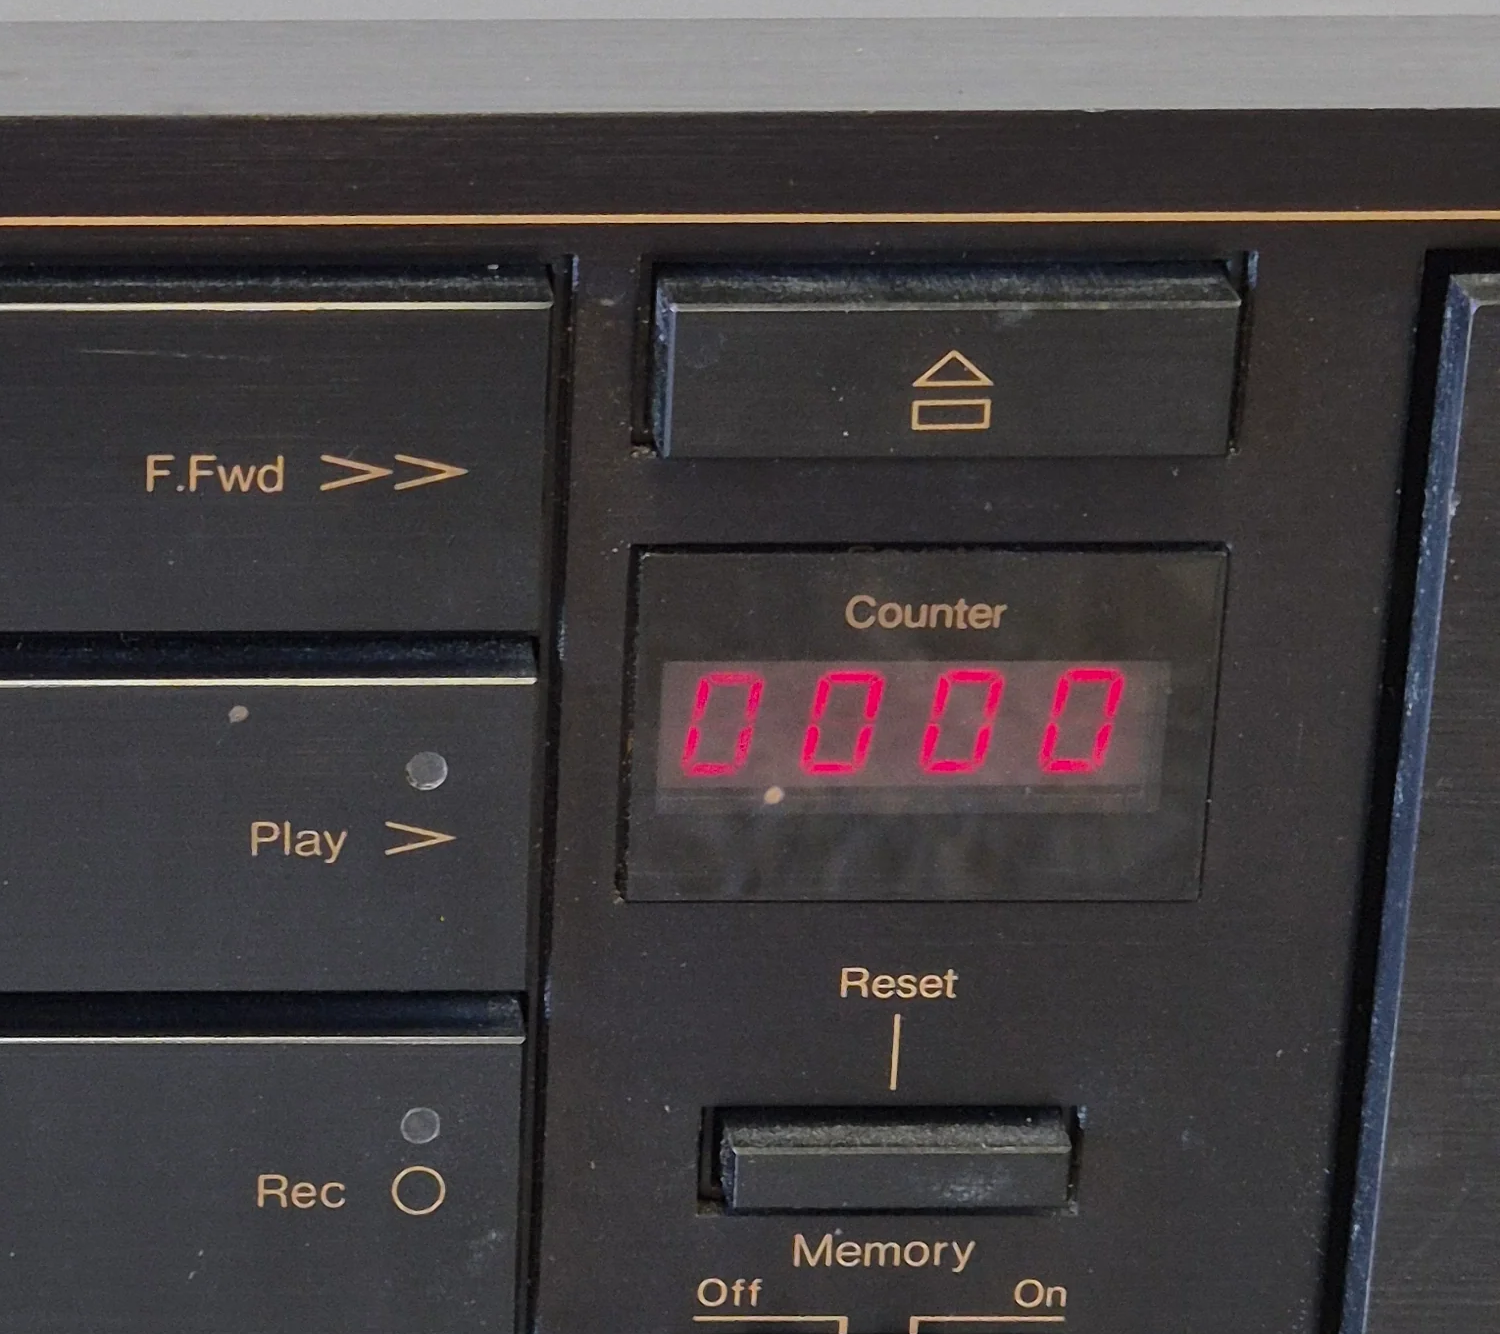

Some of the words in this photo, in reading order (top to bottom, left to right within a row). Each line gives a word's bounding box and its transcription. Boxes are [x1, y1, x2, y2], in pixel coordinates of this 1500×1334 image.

[145, 454, 285, 493] F.Fwd
[844, 594, 1007, 631] Counter
[681, 666, 1125, 777] 0000
[250, 820, 348, 864] Play
[839, 966, 958, 1000] Reset
[256, 1173, 346, 1210] Rec
[792, 1233, 976, 1273] Memory
[696, 1277, 763, 1308] Off
[1014, 1278, 1067, 1308] On
